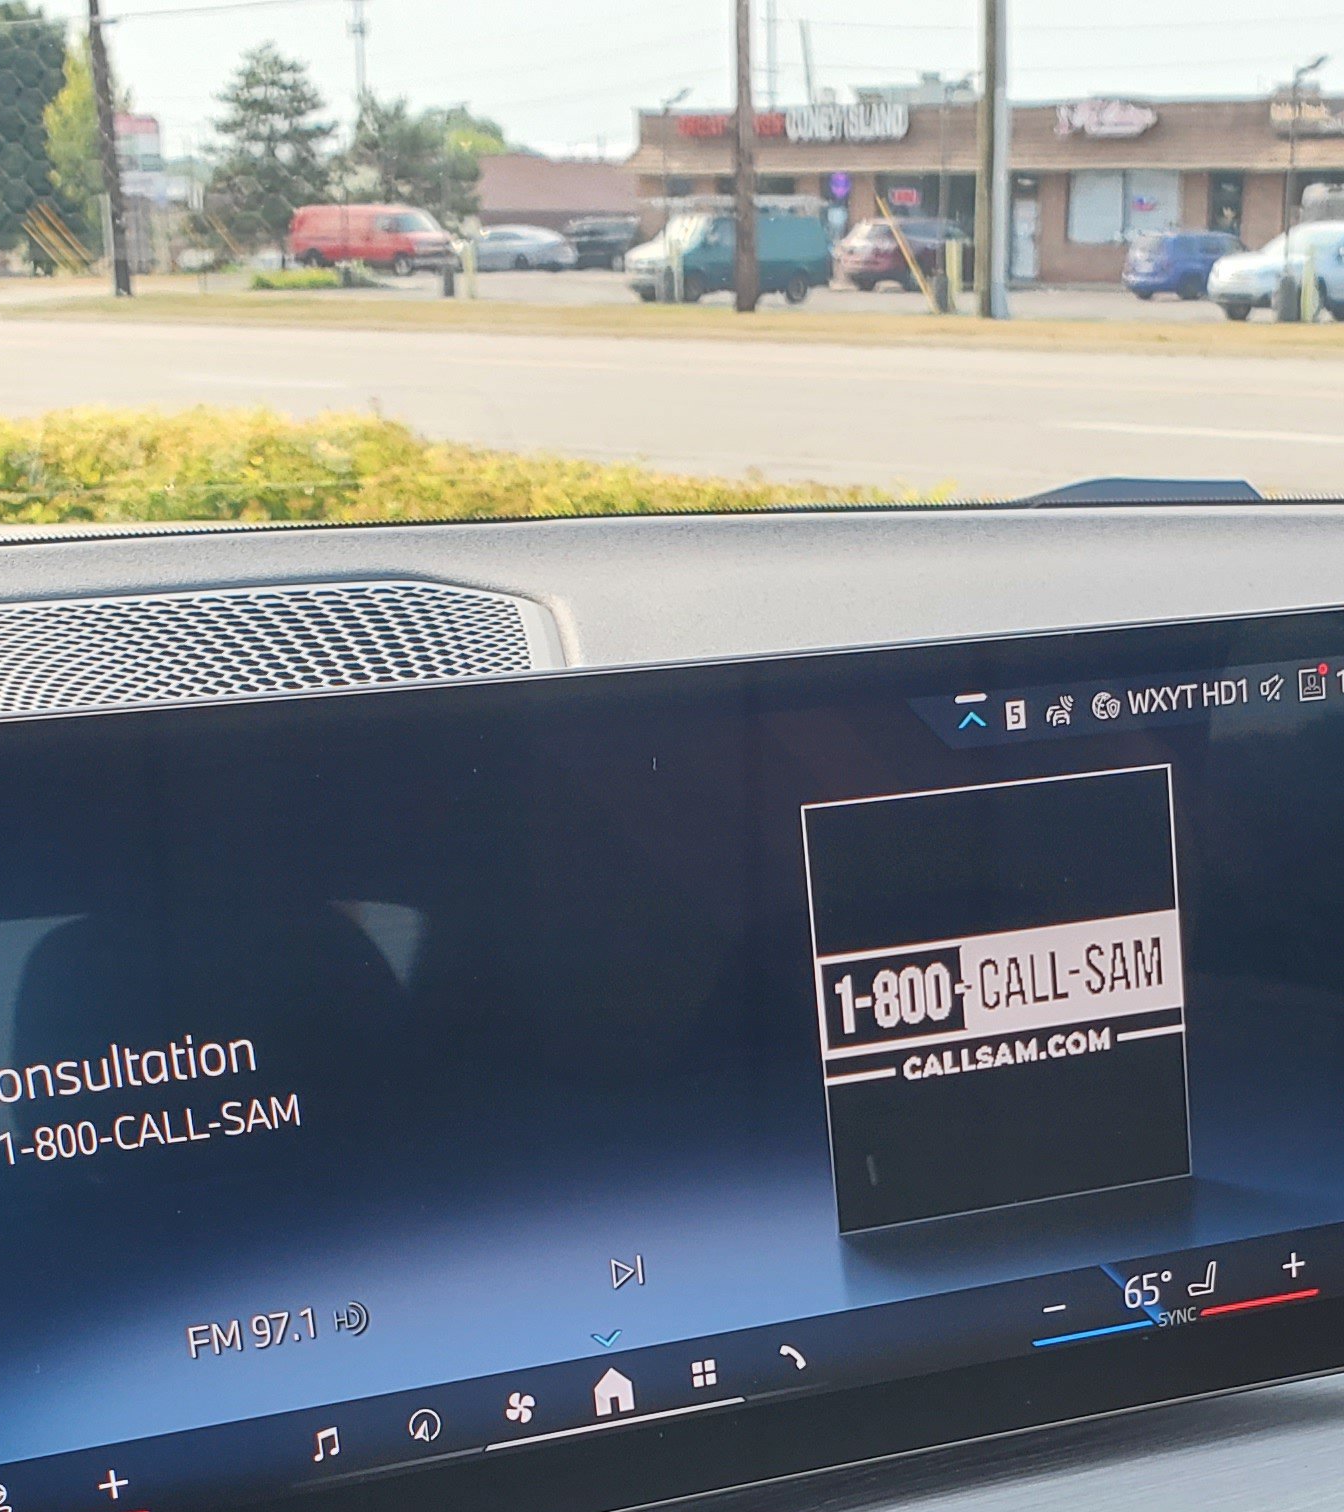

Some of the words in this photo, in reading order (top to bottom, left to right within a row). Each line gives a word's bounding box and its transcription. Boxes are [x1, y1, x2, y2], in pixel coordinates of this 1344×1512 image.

[1127, 683, 1197, 716] WXYT
[1202, 677, 1249, 707] HD1
[834, 936, 1165, 1036] 1-800-CALL-SAM
[901, 1027, 1112, 1082] CALLSAM.COM
[1123, 1268, 1173, 1311] 65°
[186, 1321, 243, 1360] FM
[252, 1307, 318, 1349] 97.1
[1157, 1305, 1198, 1328] SYNC
